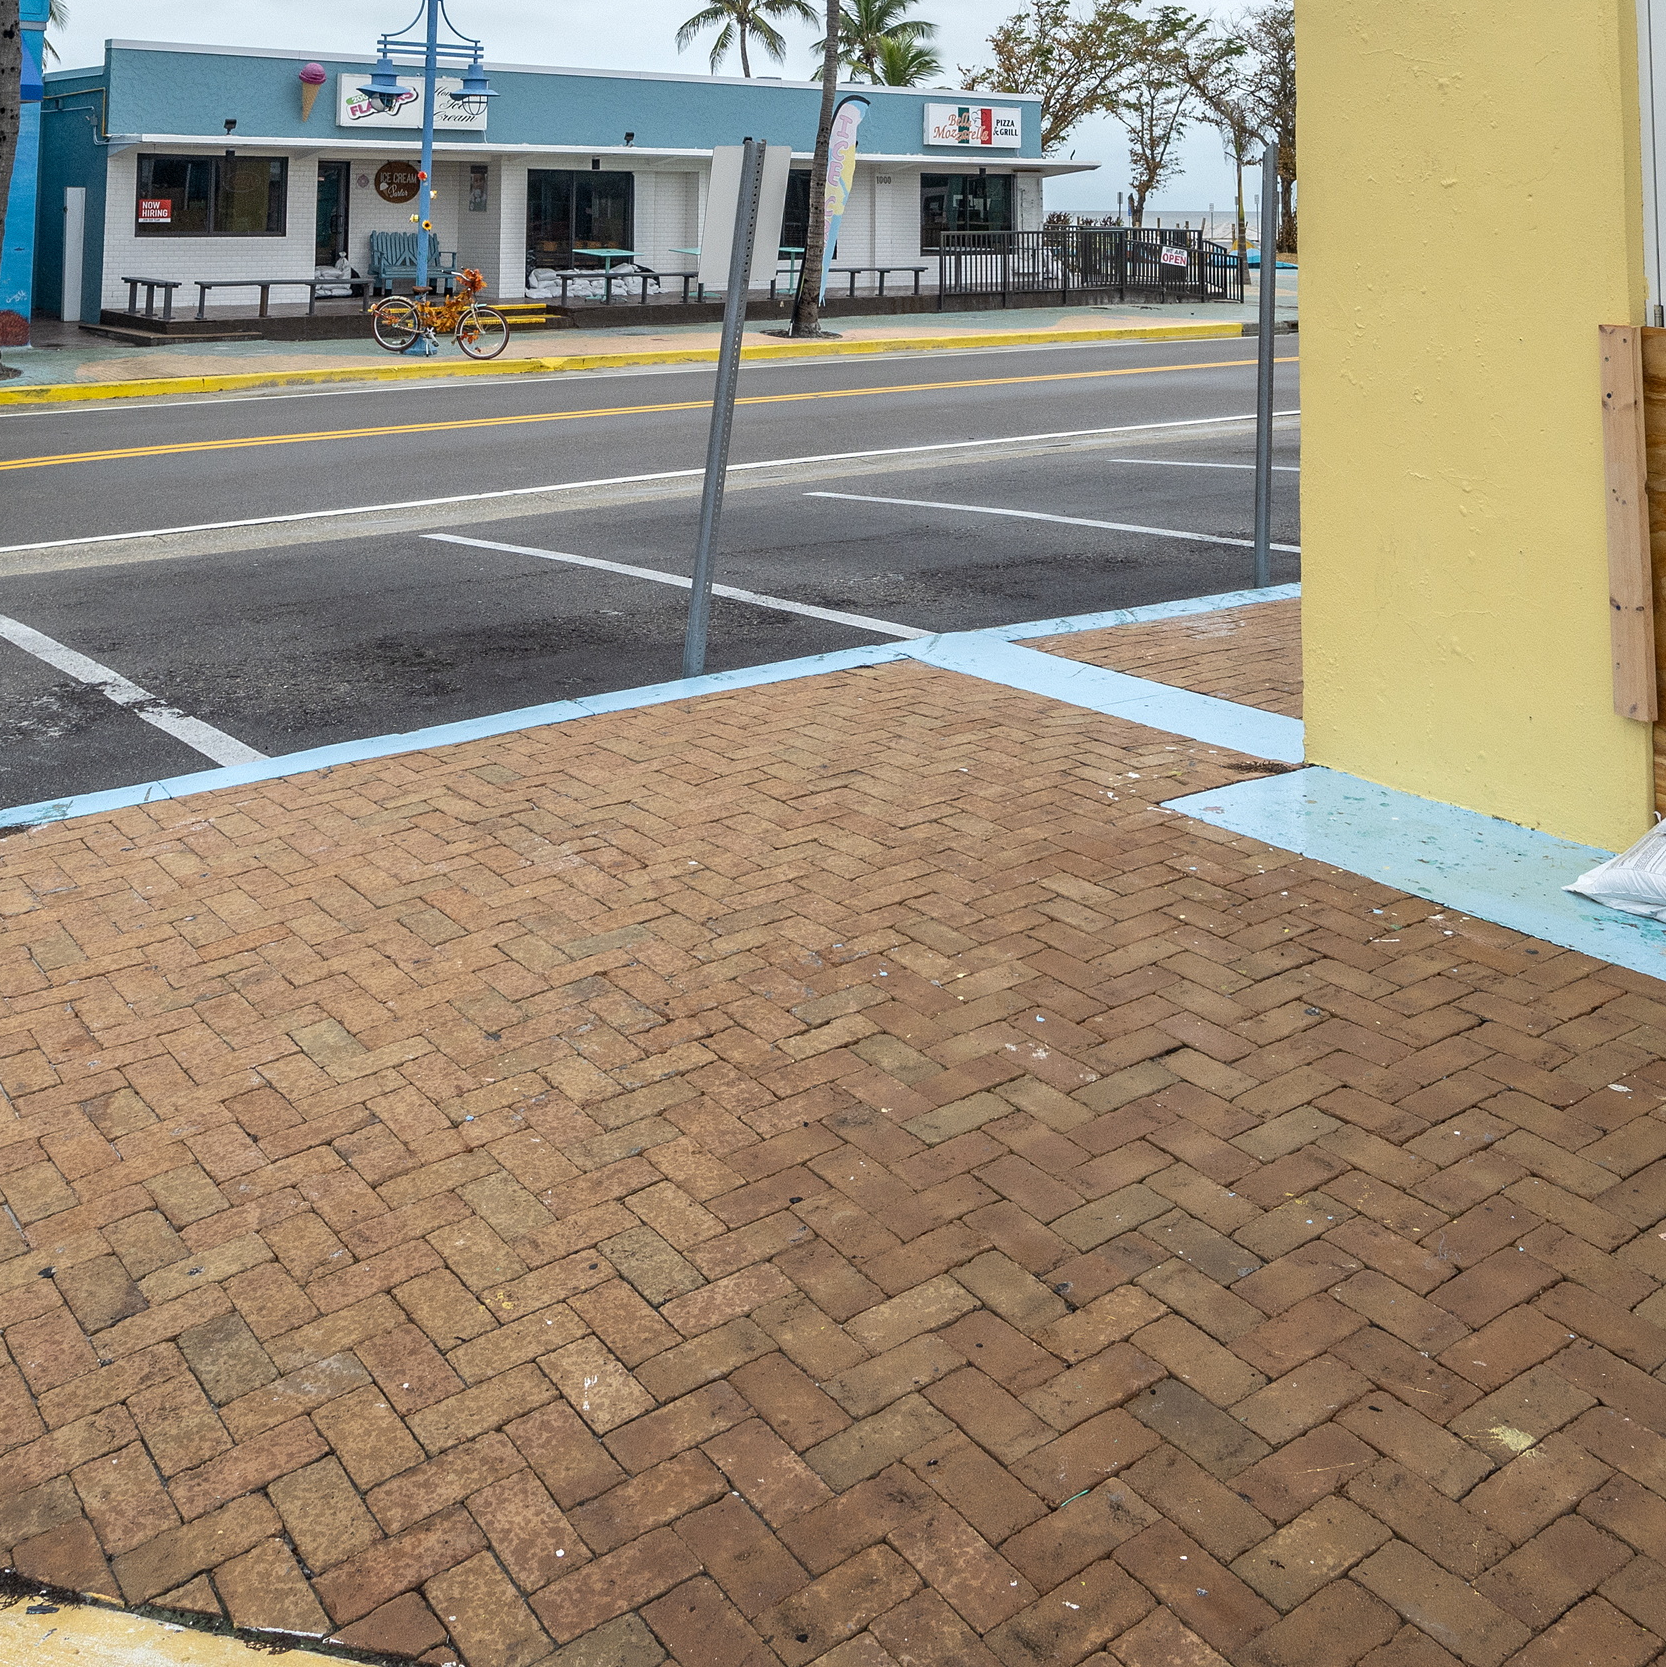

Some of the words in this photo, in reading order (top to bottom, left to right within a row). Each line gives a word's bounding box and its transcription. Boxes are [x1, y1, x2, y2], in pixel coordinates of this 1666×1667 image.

[996, 119, 1015, 127] PIZZA
[933, 125, 989, 141] Mozzarella
[1000, 128, 1018, 136] GRILL
[828, 114, 853, 187] ICE
[380, 172, 392, 183] ICE
[393, 172, 417, 184] CREAM
[142, 201, 160, 209] NOW
[1162, 253, 1187, 265] OPEN
